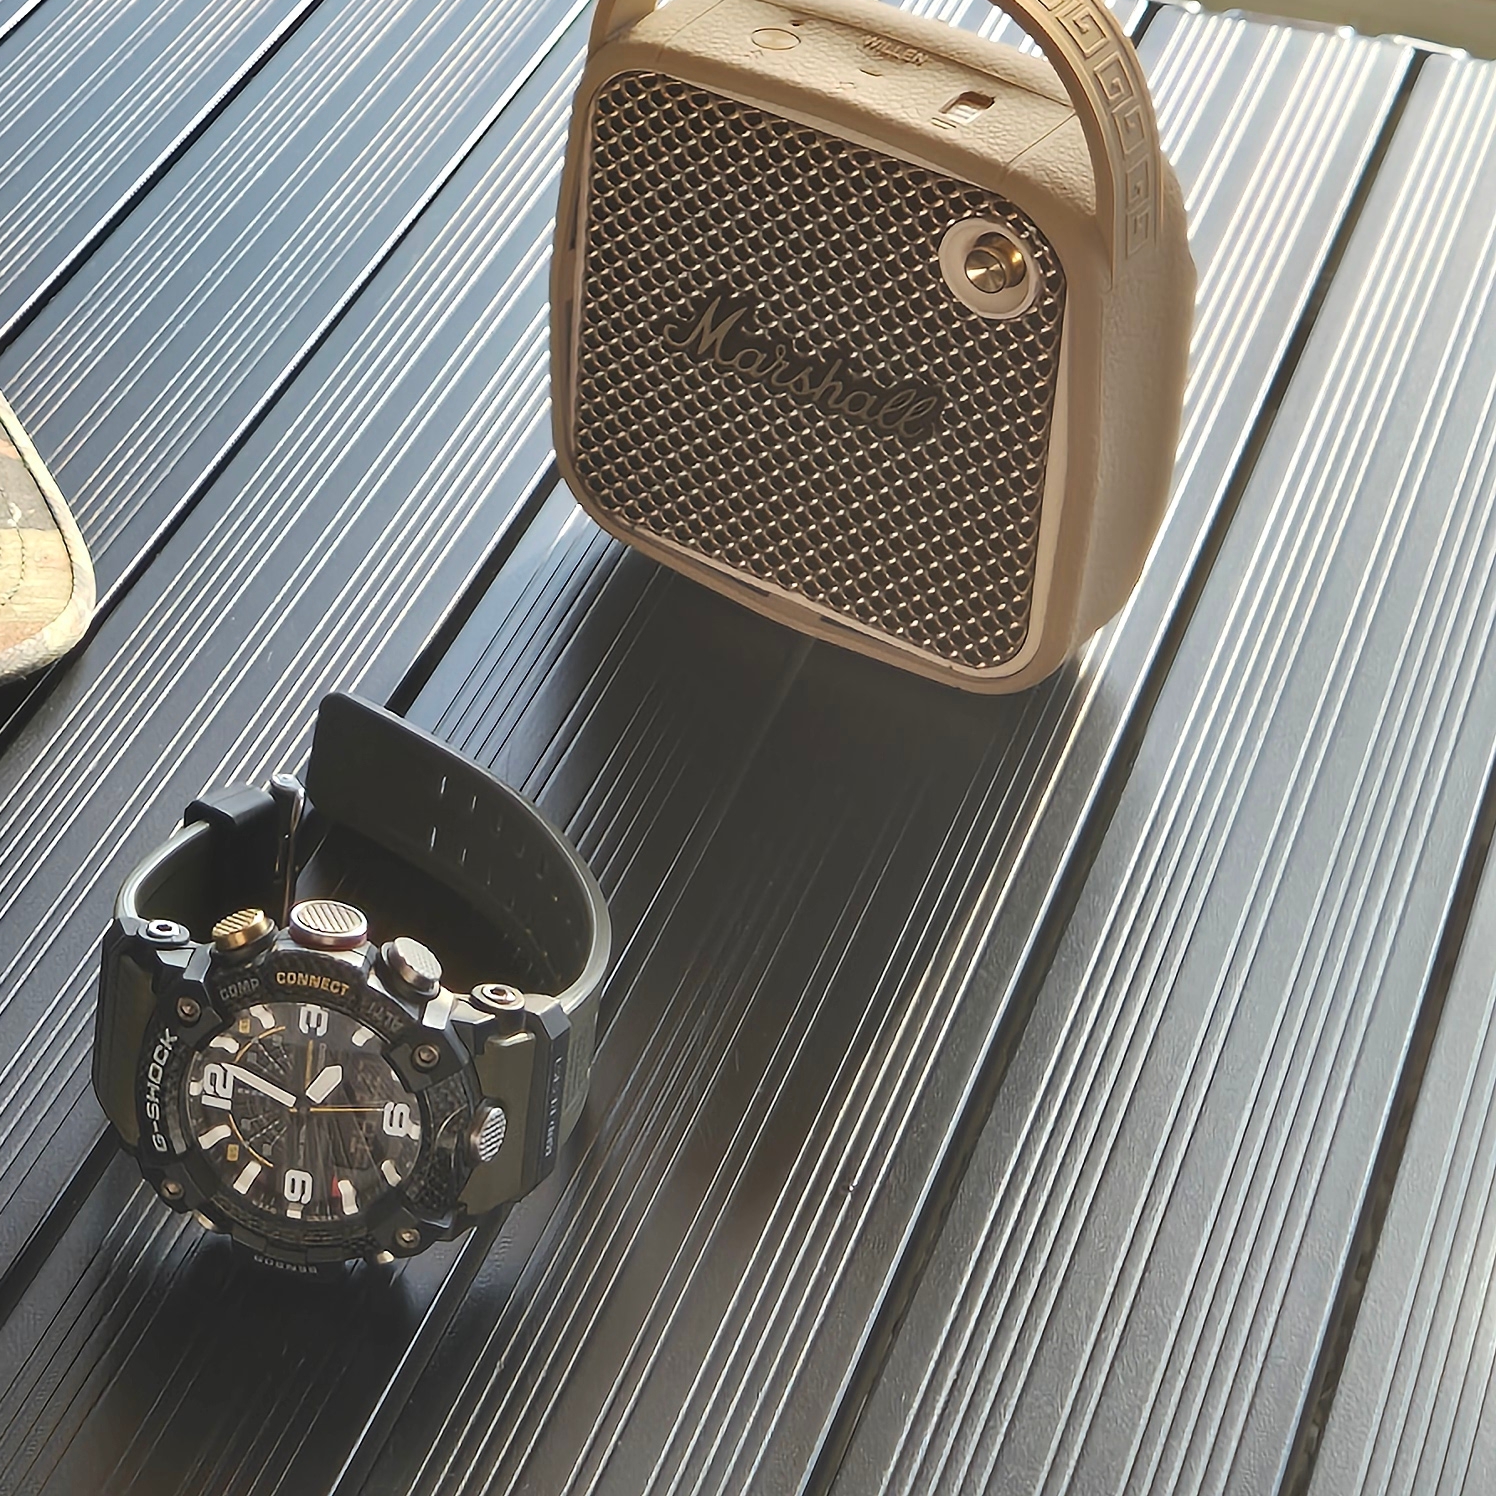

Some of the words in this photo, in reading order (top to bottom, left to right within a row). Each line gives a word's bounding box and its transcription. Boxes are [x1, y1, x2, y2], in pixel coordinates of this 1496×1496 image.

[862, 34, 929, 67] WILLEN
[663, 295, 938, 439] Marshall
[219, 977, 260, 1001] COMP
[275, 971, 350, 997] CONNECT
[146, 1027, 178, 1152] G-SHOCK
[201, 1062, 236, 1111] 12
